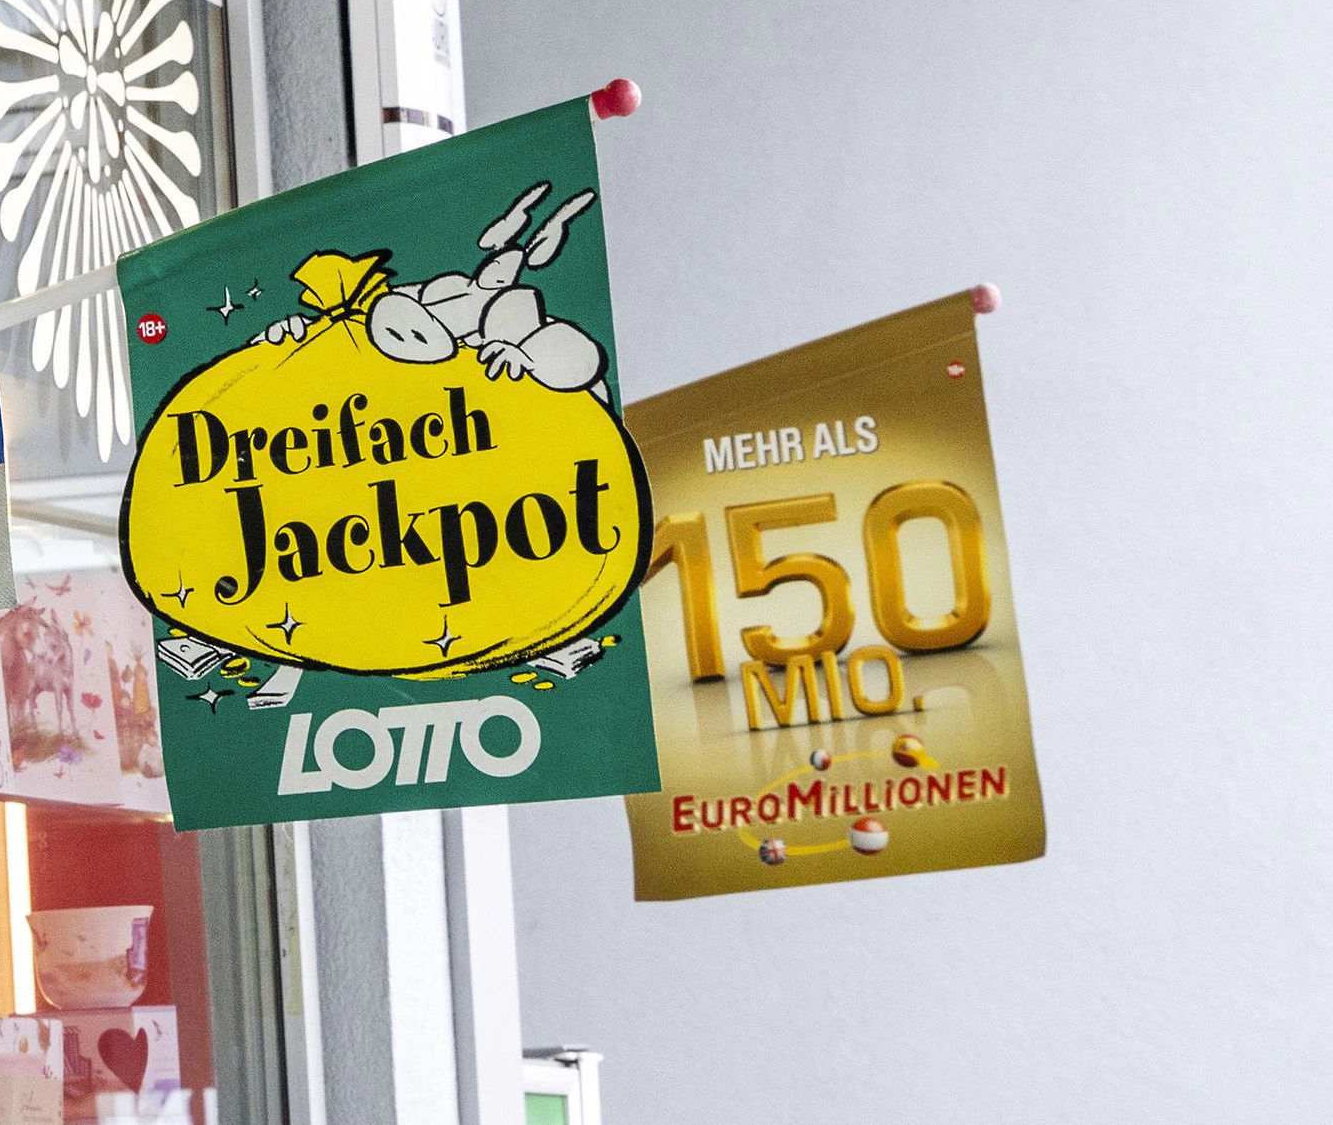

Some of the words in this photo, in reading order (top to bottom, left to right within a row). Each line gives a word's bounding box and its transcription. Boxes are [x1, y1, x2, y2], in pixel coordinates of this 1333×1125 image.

[137, 320, 166, 339] 18+
[166, 387, 498, 487] Dreifach
[703, 425, 805, 473] MEHR
[812, 415, 878, 459] ALS
[214, 459, 621, 608] Jackpot
[640, 479, 992, 683] 150
[740, 645, 925, 732] MIO.
[277, 695, 542, 796] LOTTO
